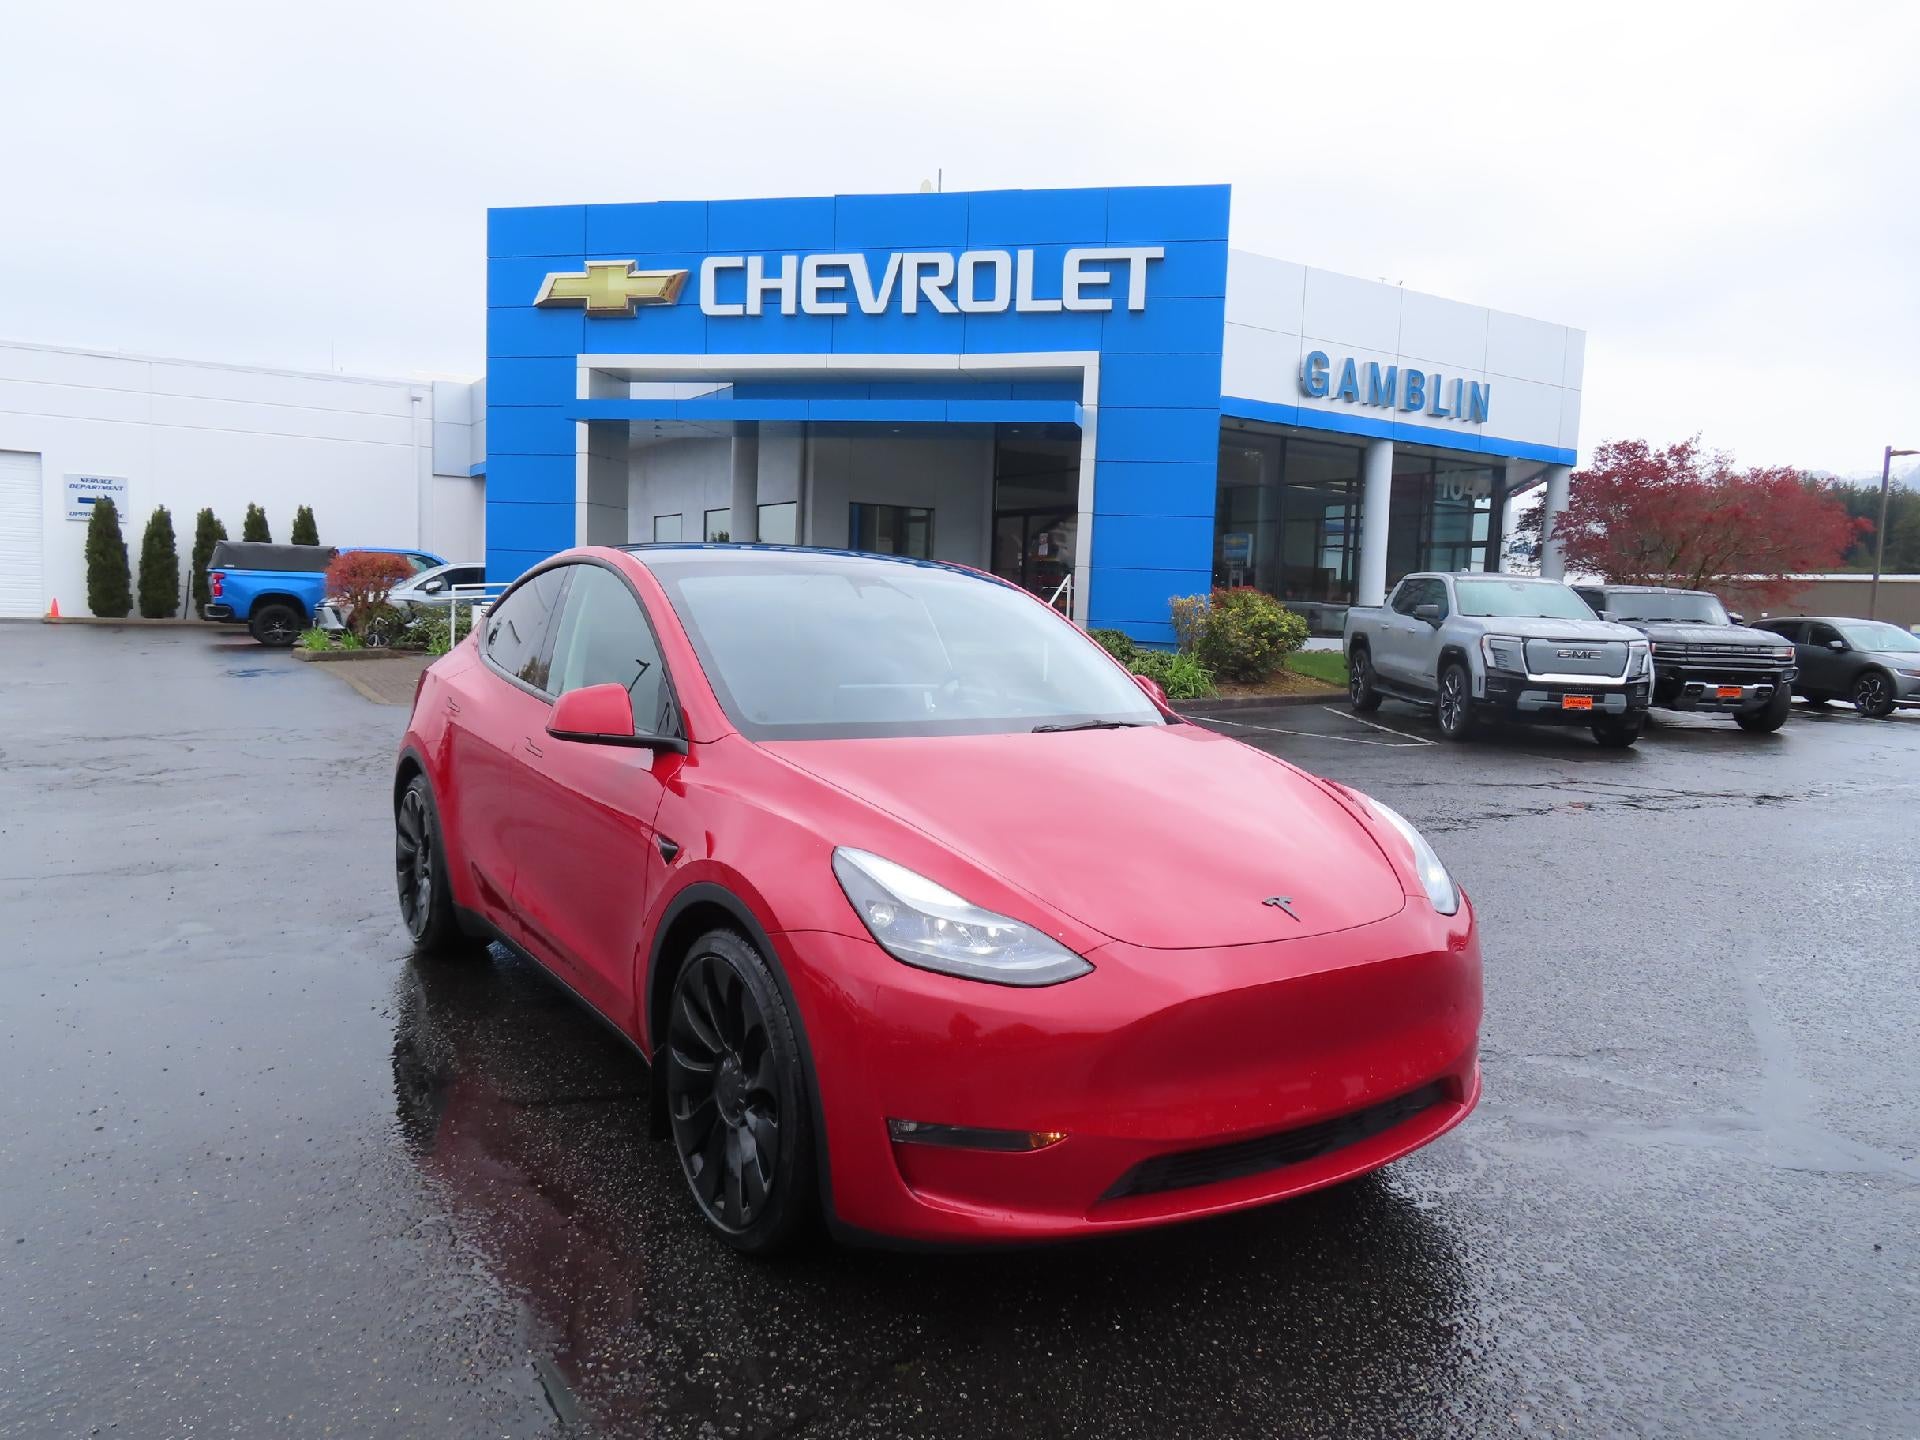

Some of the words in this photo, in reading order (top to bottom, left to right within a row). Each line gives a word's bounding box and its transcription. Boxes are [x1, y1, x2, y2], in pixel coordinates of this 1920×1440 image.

[700, 246, 1165, 315] CHEVROLET
[1301, 350, 1491, 424] GAMBLIN
[80, 477, 113, 485] SERVICE
[69, 483, 124, 491] DEPARTMENT
[1557, 649, 1603, 660] GMC
